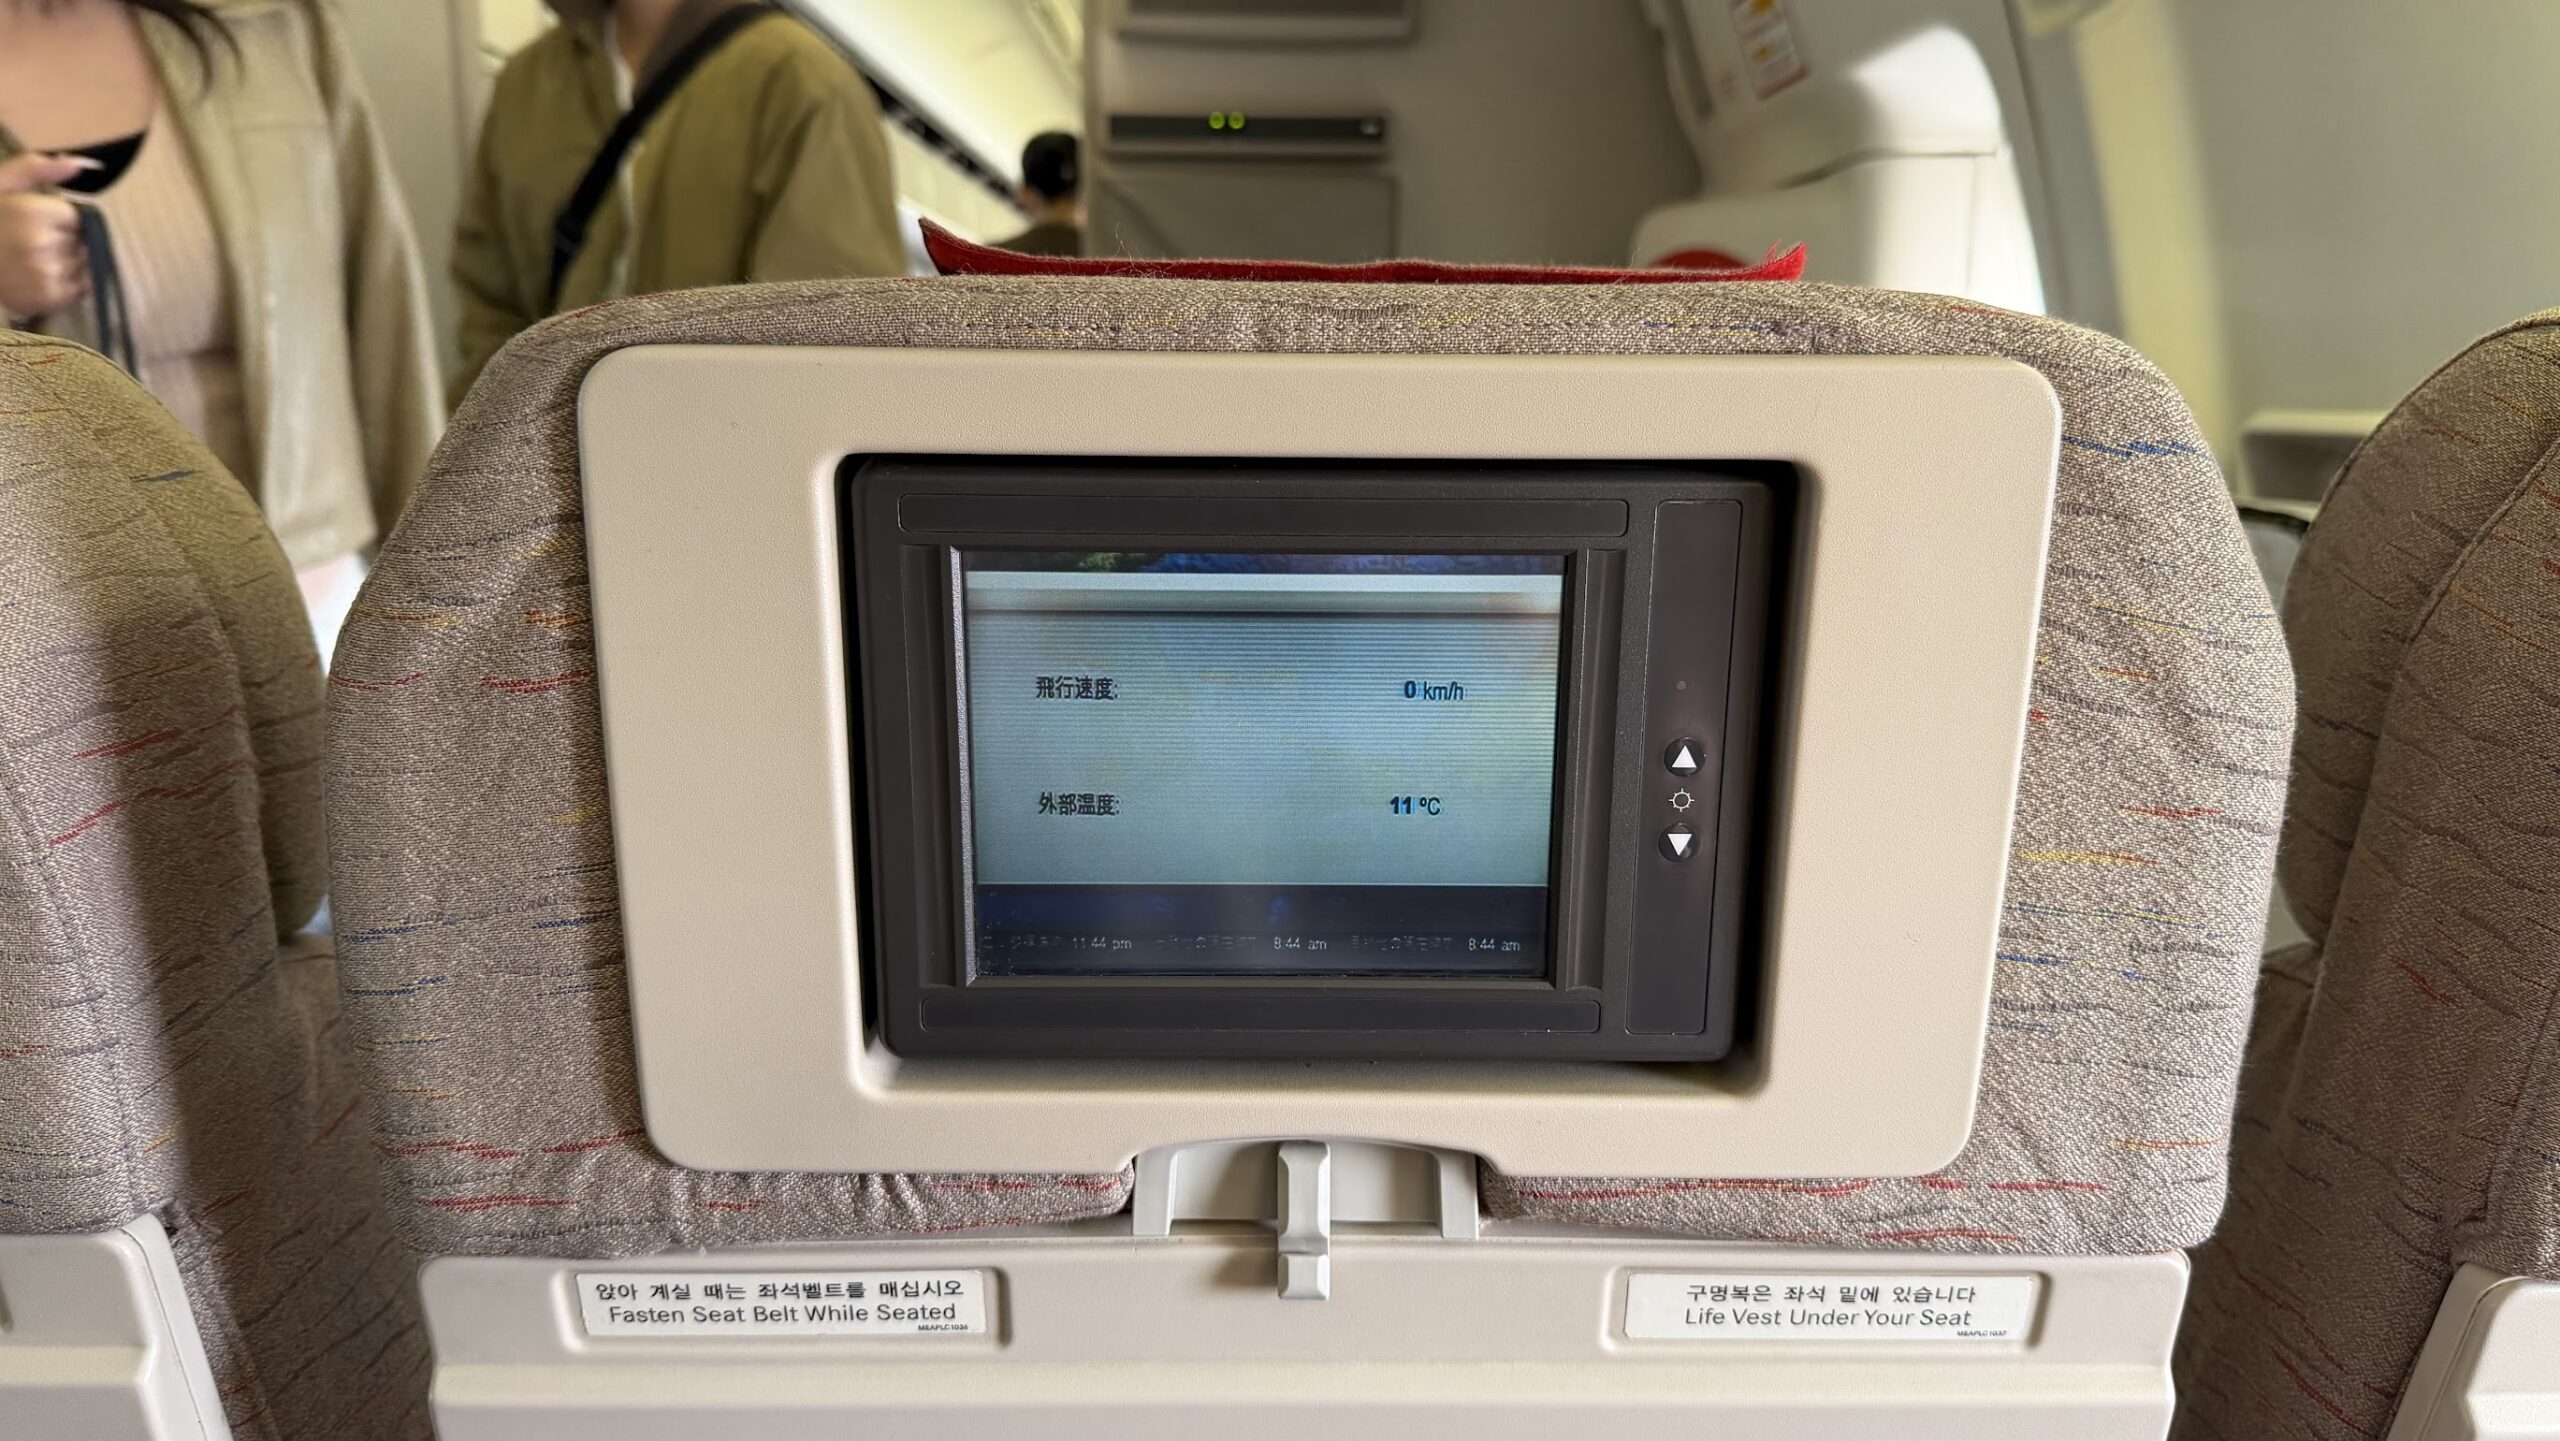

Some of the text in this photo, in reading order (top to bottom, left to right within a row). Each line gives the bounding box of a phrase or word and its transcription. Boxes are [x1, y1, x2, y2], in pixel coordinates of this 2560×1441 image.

[1404, 680, 1464, 700] 0 km/h
[1390, 796, 1412, 815] 11
[1112, 939, 1132, 951] pm
[1273, 936, 1327, 950] 8:44 am
[1468, 937, 1520, 951] 8:44 am
[596, 1279, 965, 1301] 앉아 계실 때는 좌석벨트를 매십시오
[1687, 1285, 1976, 1303] 구명복은 좌석 밑에 있습니다
[610, 1303, 956, 1323] Fasten Seat Belt While Seated
[1685, 1307, 1972, 1326] Life Vest Under Your Seat
